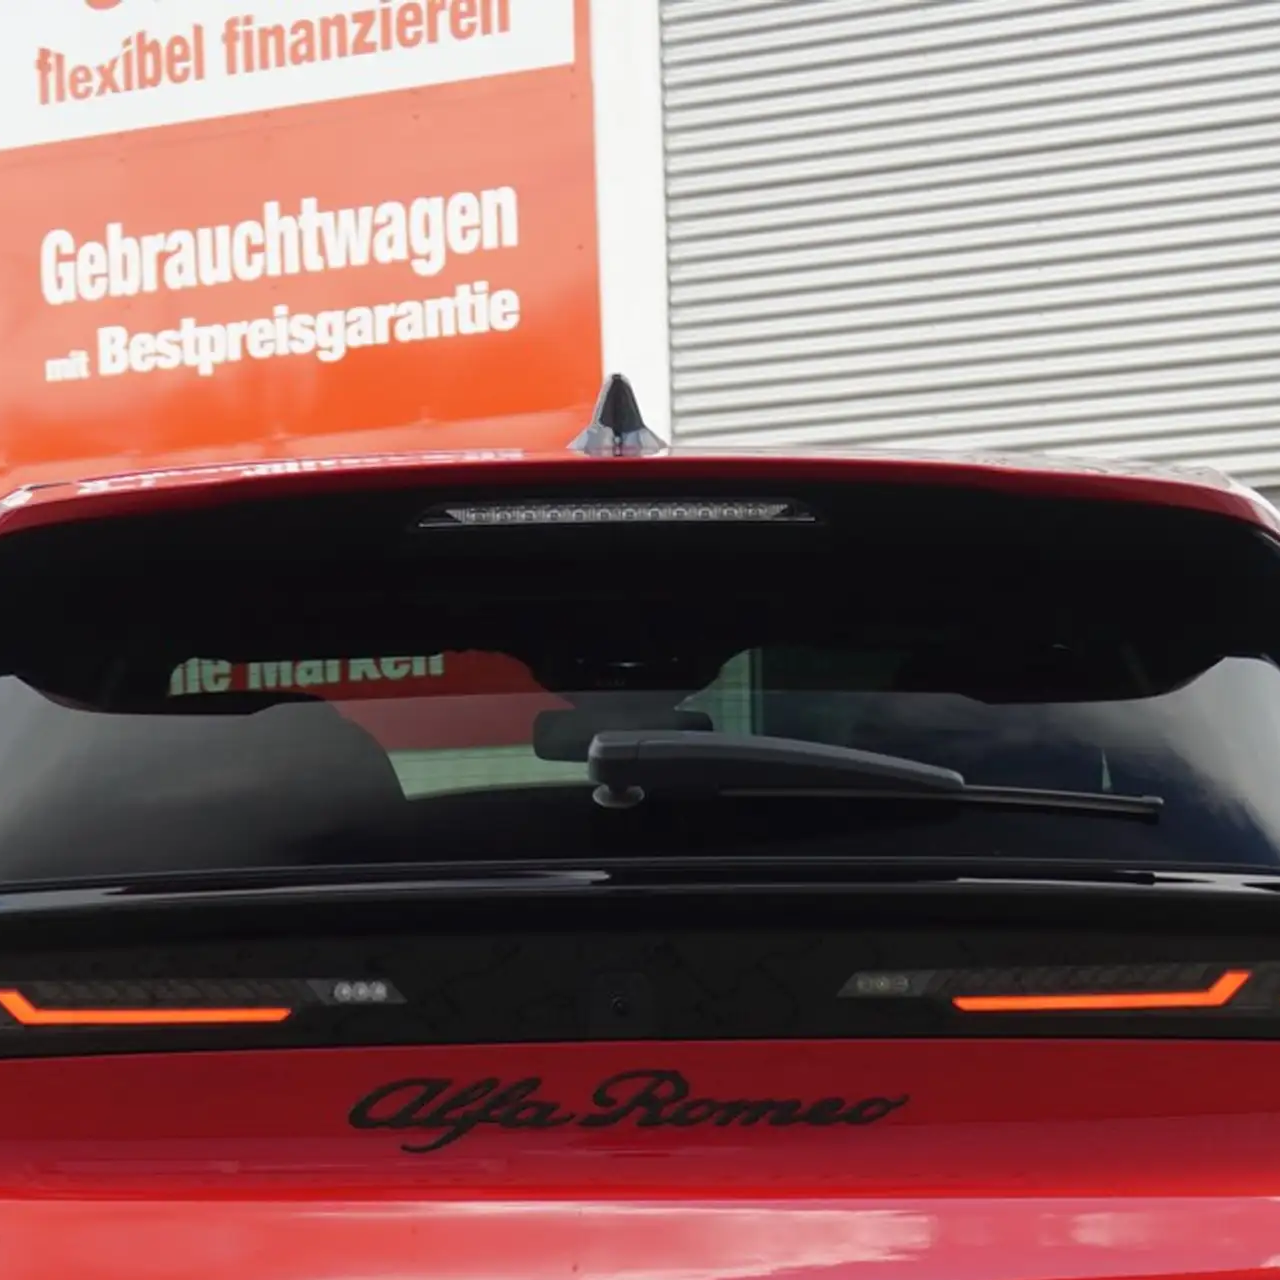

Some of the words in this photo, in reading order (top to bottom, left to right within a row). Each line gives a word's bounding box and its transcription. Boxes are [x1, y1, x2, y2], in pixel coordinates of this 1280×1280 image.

[36, 25, 204, 104] flexibel
[222, 0, 510, 76] finanzieren
[39, 186, 519, 305] Gebrauchtwagen
[97, 281, 520, 375] Bestpreisgarantie
[348, 1076, 575, 1153] Alfa
[578, 1069, 910, 1130] Romeo
